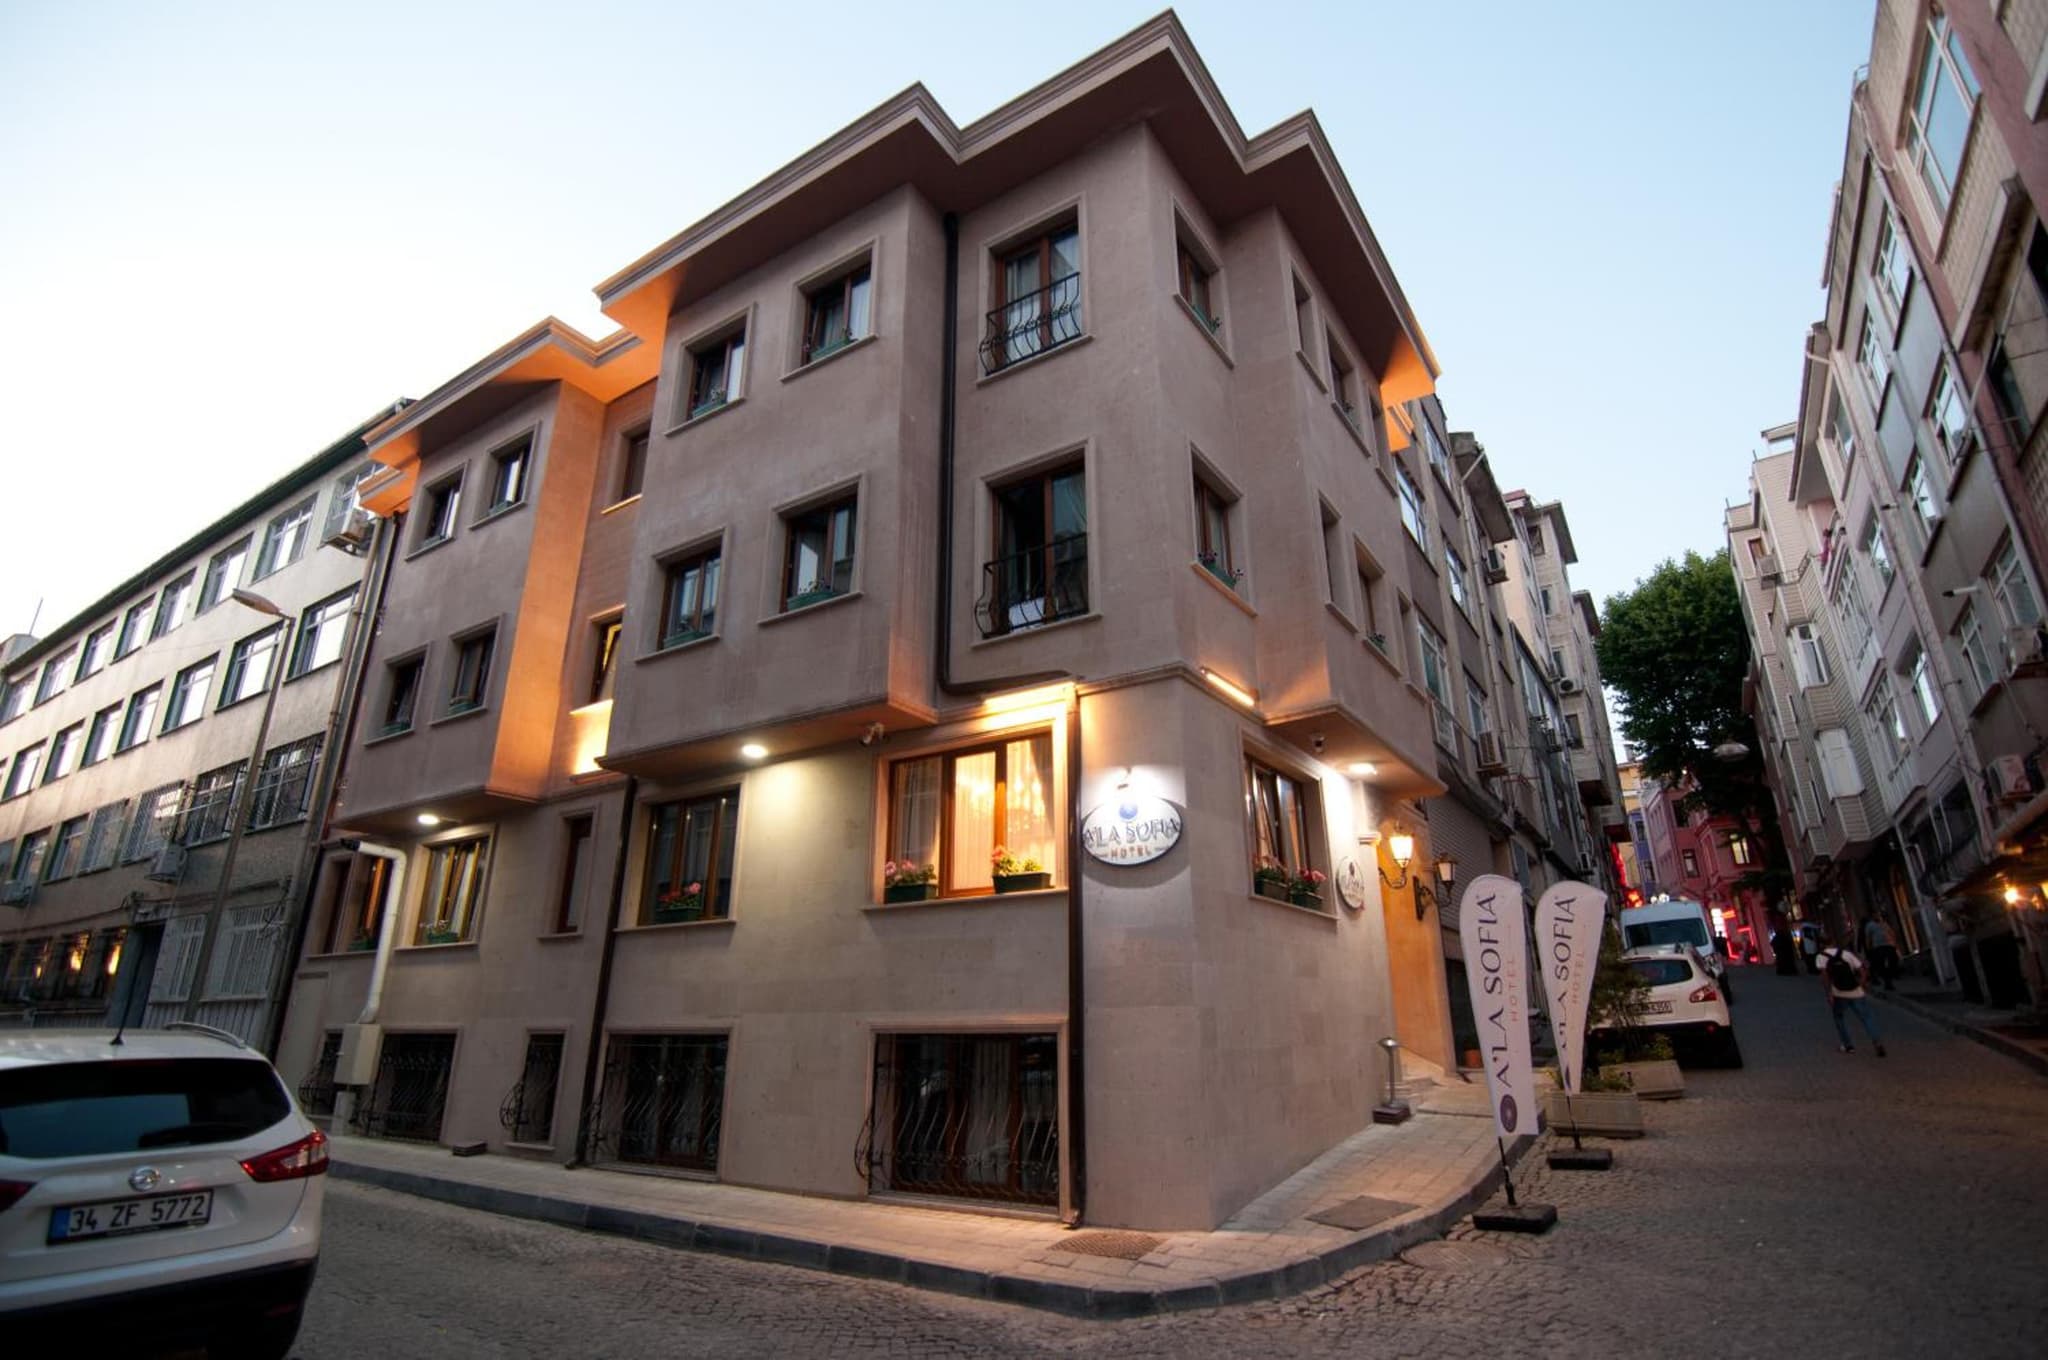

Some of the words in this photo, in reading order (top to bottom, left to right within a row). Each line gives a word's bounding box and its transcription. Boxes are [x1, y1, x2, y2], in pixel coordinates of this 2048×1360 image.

[1111, 846, 1152, 859] HOTEL
[1476, 894, 1504, 995] SOFIA
[1553, 896, 1576, 981] SOFIA
[1507, 958, 1519, 1023] HOTEL
[1572, 951, 1587, 1004] HOTEL
[1488, 1006, 1512, 1089] A'LA
[71, 1209, 97, 1232] 34
[111, 1203, 140, 1227] ZF
[151, 1196, 204, 1221] 5772
